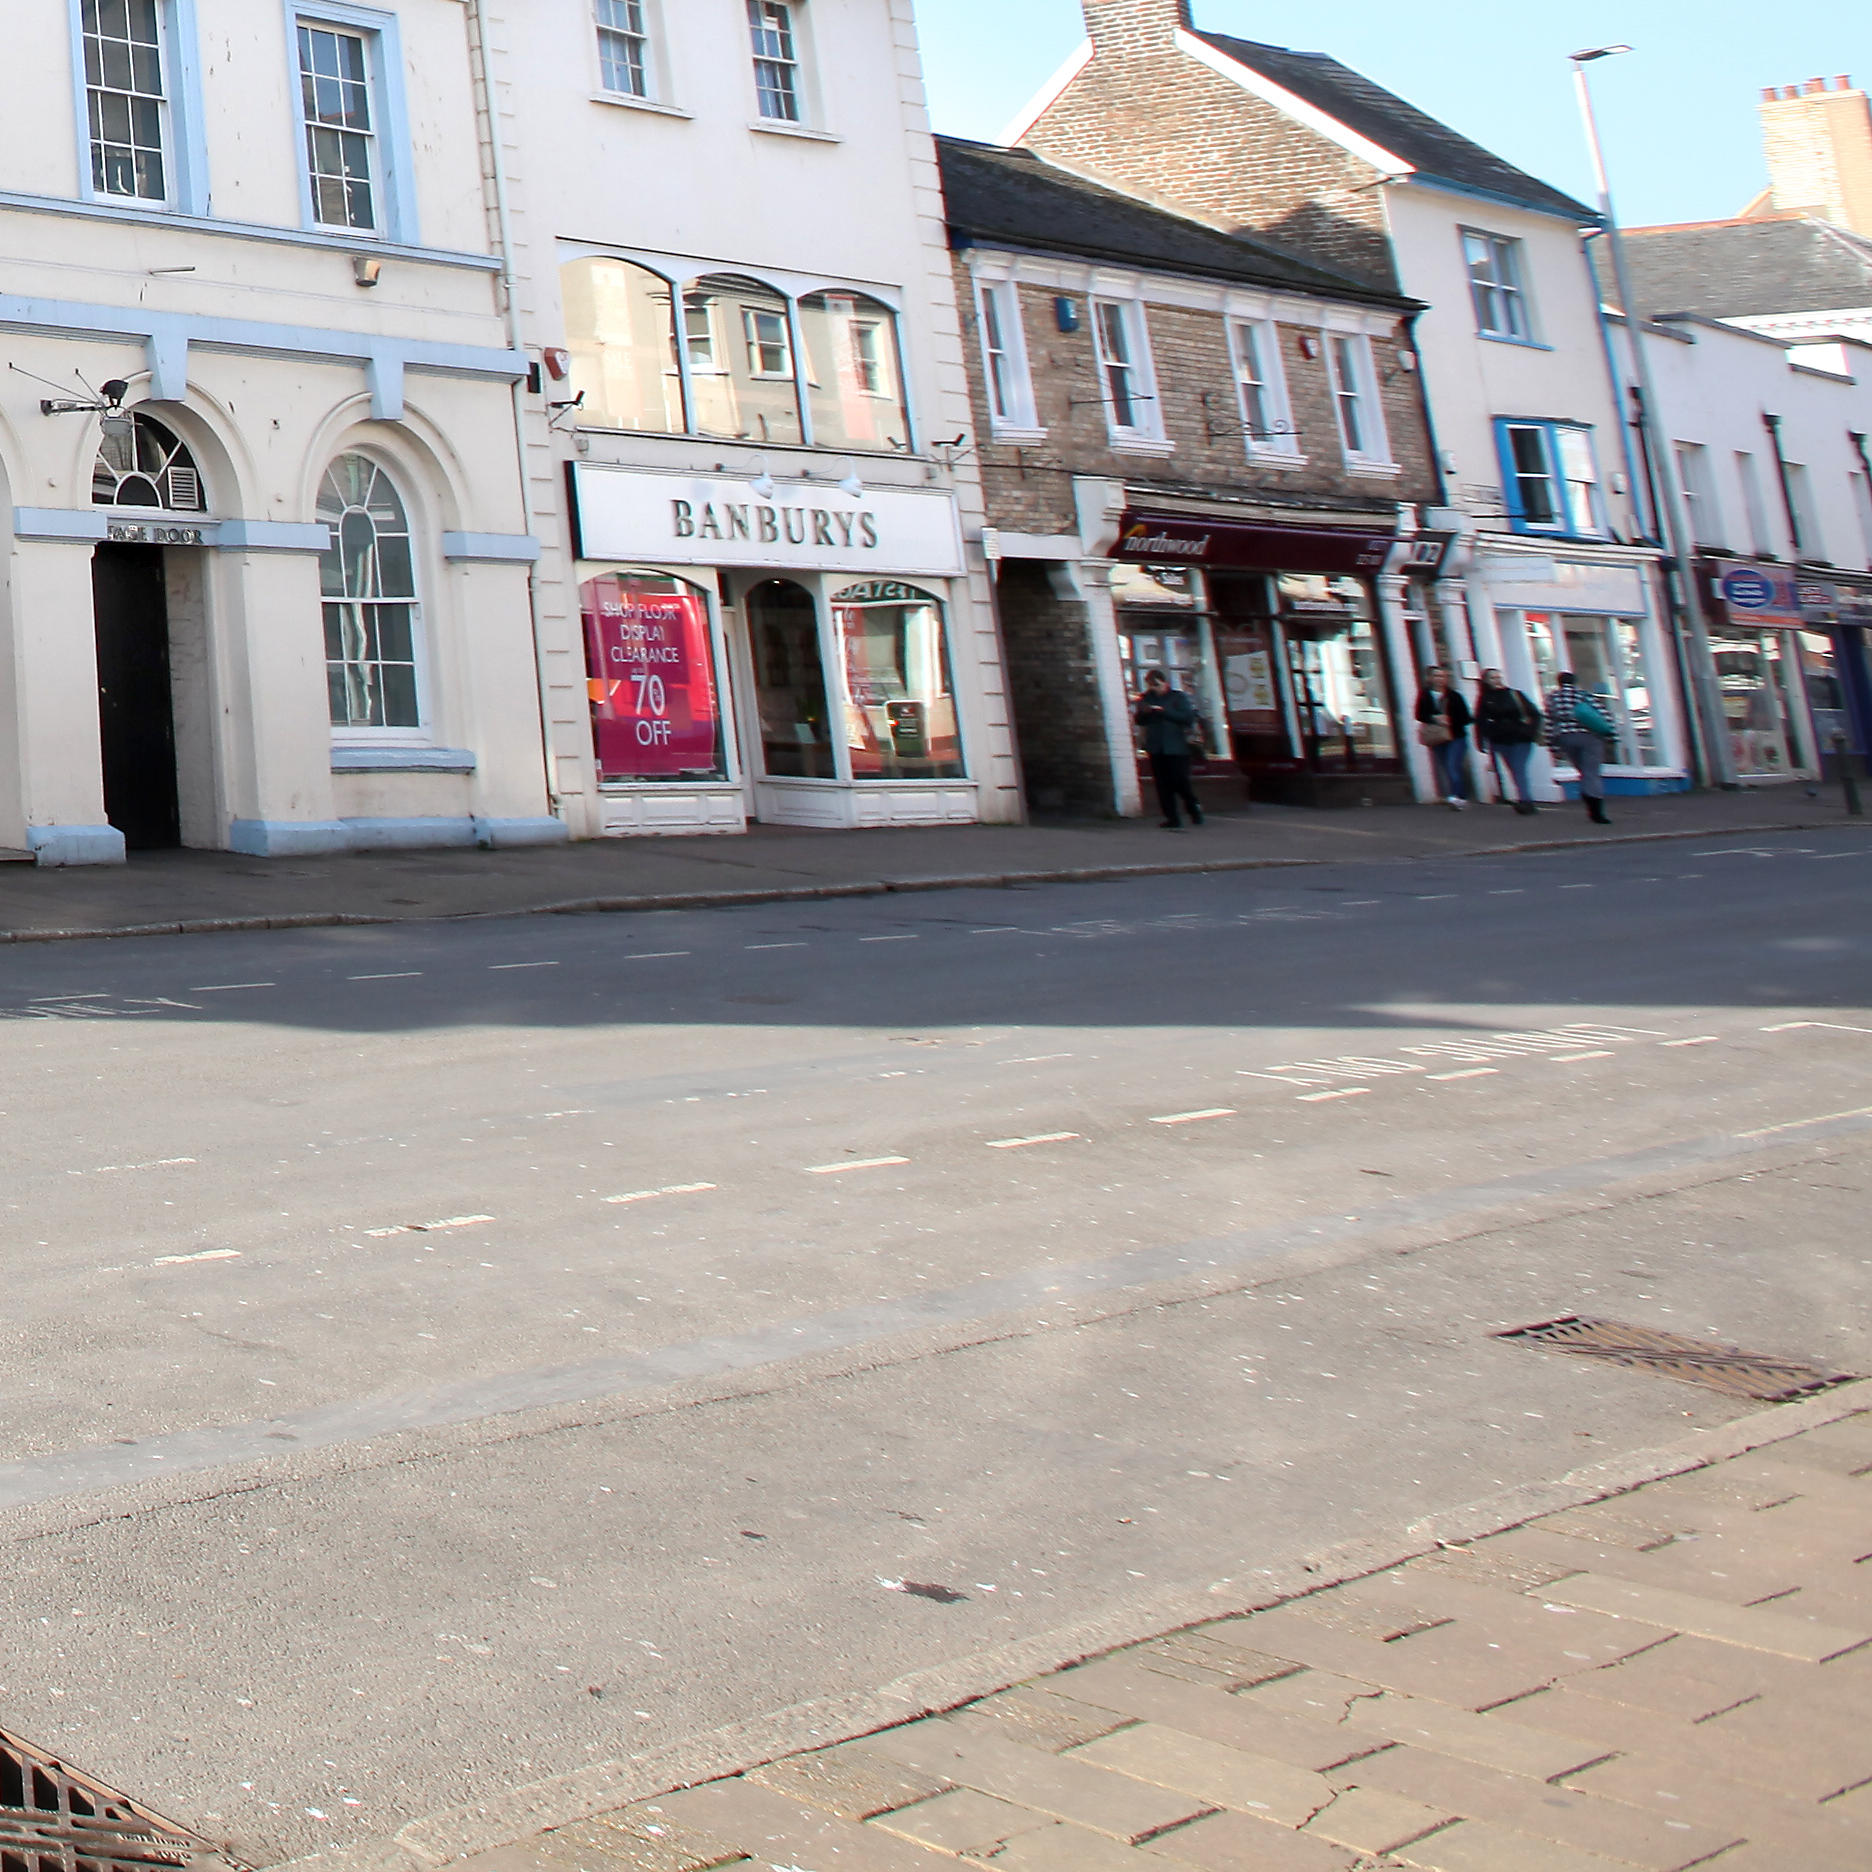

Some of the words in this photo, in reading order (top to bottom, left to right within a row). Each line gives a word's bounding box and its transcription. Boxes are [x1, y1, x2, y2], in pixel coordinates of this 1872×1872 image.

[155, 528, 203, 544] DOOR
[670, 499, 879, 549] BANBURYS
[1125, 531, 1210, 556] northwood
[603, 602, 634, 617] SHOP
[611, 647, 679, 662] CLEARANCE
[636, 720, 671, 745] OFF
[1399, 1023, 1668, 1062] LOADING
[1235, 1055, 1426, 1086] ONLY
